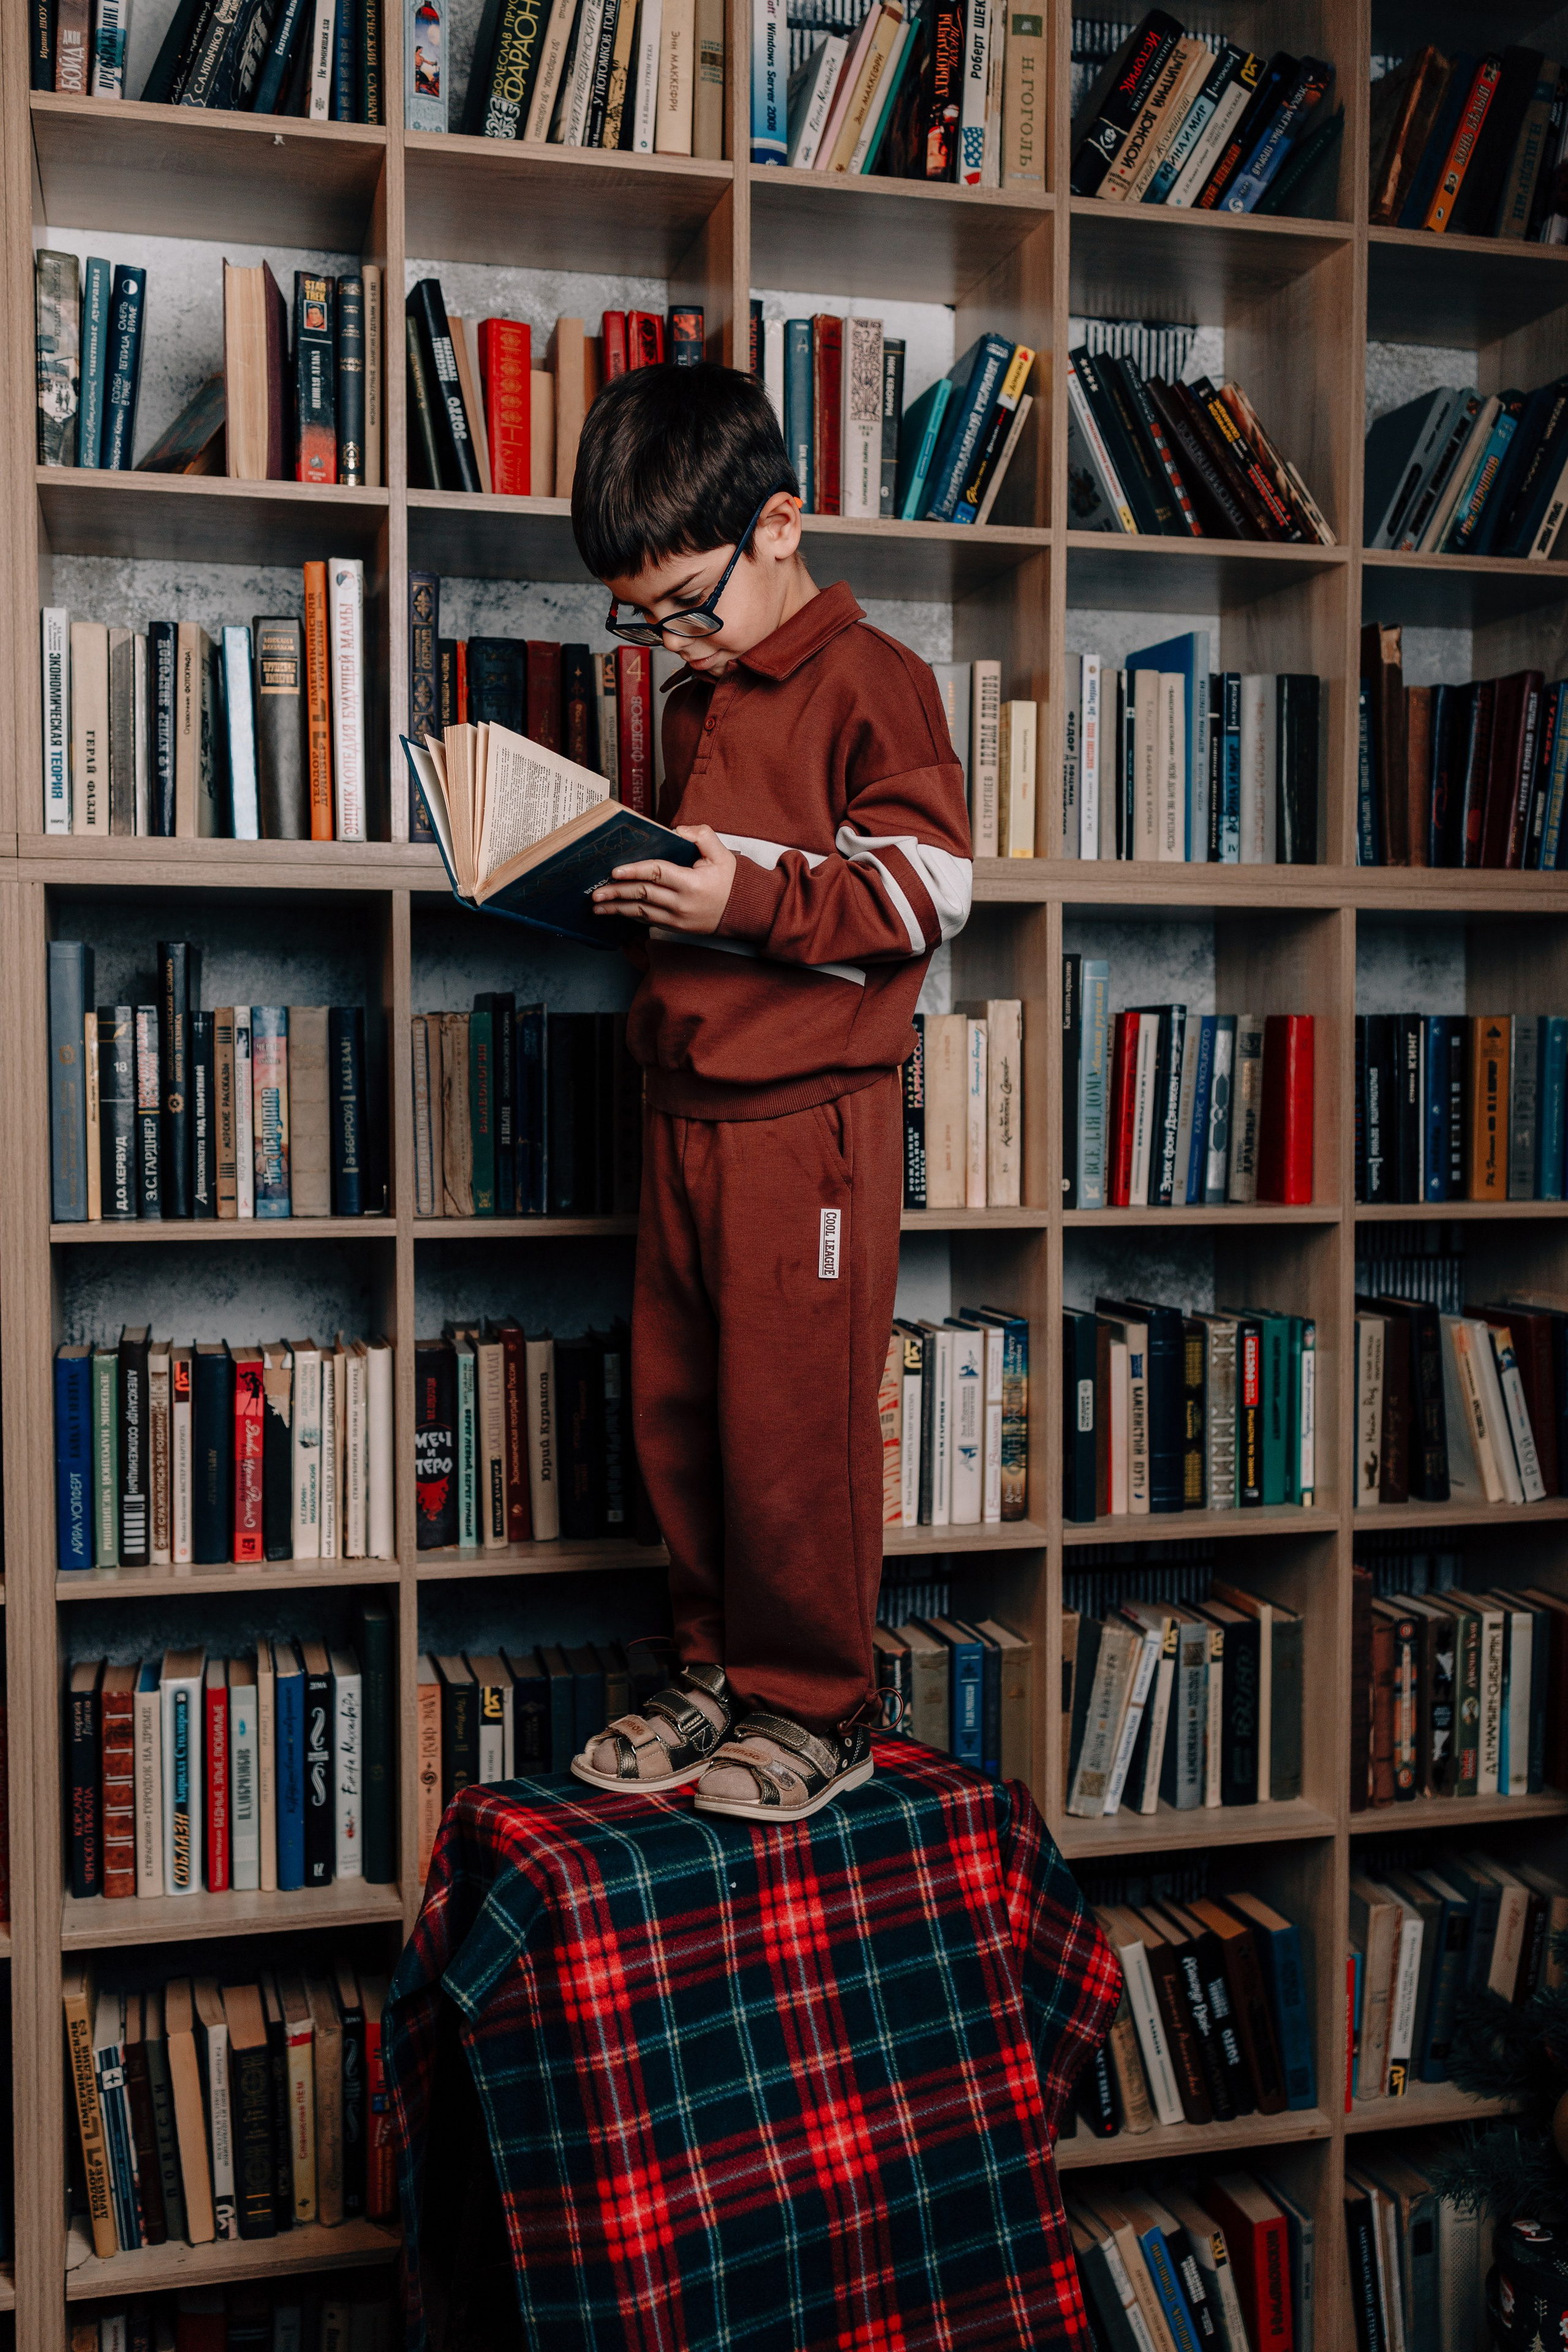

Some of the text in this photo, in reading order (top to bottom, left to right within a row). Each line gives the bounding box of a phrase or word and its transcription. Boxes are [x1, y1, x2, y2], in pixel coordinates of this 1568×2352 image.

[38, 5, 48, 58] Ирвин ШОУ
[62, 30, 80, 44] ДЖОН
[99, 6, 119, 89] ПРЕОБРАЖЕНИЕ
[275, 18, 292, 55] Екатерина
[319, 32, 329, 67] помнящая
[503, 0, 542, 102] ФАРАОН
[571, 9, 598, 106] ЛИБЕДИНСКИЙ
[767, 23, 777, 66] Windows
[971, 34, 984, 80] Роберт
[59, 47, 84, 90] БОЙД
[317, 69, 327, 78] Не
[492, 31, 513, 96] БОЛЕСЛАВ
[594, 34, 613, 92] ПОТОМКОВ
[669, 54, 679, 111] МАККЕФРИ
[767, 71, 776, 102] Server
[861, 53, 886, 106] МАККЕФРИ
[1120, 31, 1161, 96] ИСТОРИК
[593, 94, 604, 106] У
[767, 105, 777, 132] 2008
[1020, 78, 1035, 167] ГОГОЛЬ
[1120, 49, 1187, 170] ДМИТРИЙ ДОНСКОЙ
[1159, 141, 1188, 183] ВОЙНА
[1189, 105, 1207, 133] МИР
[1453, 133, 1474, 167] КОНЬ
[304, 280, 325, 292] STAR
[306, 291, 325, 303] TREK
[886, 356, 896, 375] НИК
[447, 396, 468, 440] ЗОРРО
[307, 592, 317, 706] АМЕРИКАНСКАЯ
[421, 629, 432, 668] ОБРЫВ
[157, 639, 171, 752] КУПЕР ЗВЕРОБОЙ
[339, 602, 360, 835] ЭНЦИКЛОПЕДИЯ БУДУЩЕЙ МАМЫ
[49, 653, 62, 799] ЭКОНОМИЧЕСКАЯ ТЕОРИЯ
[631, 696, 644, 762] ФЕДОРОВ
[981, 675, 997, 818] ТУРГЕНЕВ ПЕРВАЯ ЛЮБОВЬ
[1067, 711, 1076, 751] ФЕДОР
[86, 731, 96, 825] ГЕРАЙ ФАЗЛИ
[312, 751, 320, 807] ТЕОДОР
[1227, 744, 1238, 772] МИР
[341, 1036, 352, 1090] ТАРЗАН
[143, 1118, 157, 1175] ГАРДНЕР
[222, 1111, 232, 1148] МОРСКИЕ
[1086, 1116, 1101, 1143] ДЛЯ
[1160, 1076, 1179, 1191] Эрих фон Дэникен
[115, 1136, 127, 1185] КЕРВУД
[1085, 1145, 1101, 1175] ВСЕ
[824, 1212, 837, 1275] COOL LEAGUE
[126, 1370, 139, 1494] АЛЕКСАНДР СОЛЖЕНИЦЫН
[156, 1413, 165, 1451] РОДИНУ
[509, 1390, 519, 1428] география
[540, 1372, 551, 1481] Юрий Куранов
[100, 1371, 113, 1550] ЛЕЧЕБНИК НАРОДНОЙ МЕДИЦИНЫ
[415, 1431, 452, 1449] МЕЧ
[510, 1429, 521, 1485] Экономическая
[70, 1472, 83, 1555] АЙРА УОЛФЕРТ
[156, 1467, 165, 1525] СРАЖАЛИСЬ
[157, 1528, 167, 1549] ОНИ
[74, 1787, 83, 1836] КОРСАРЫ
[85, 1838, 94, 1883] ЧЕРНОГО
[174, 1812, 189, 1886] СОБЛАЗН
[154, 2083, 177, 2198] ПОВЕСТИ
